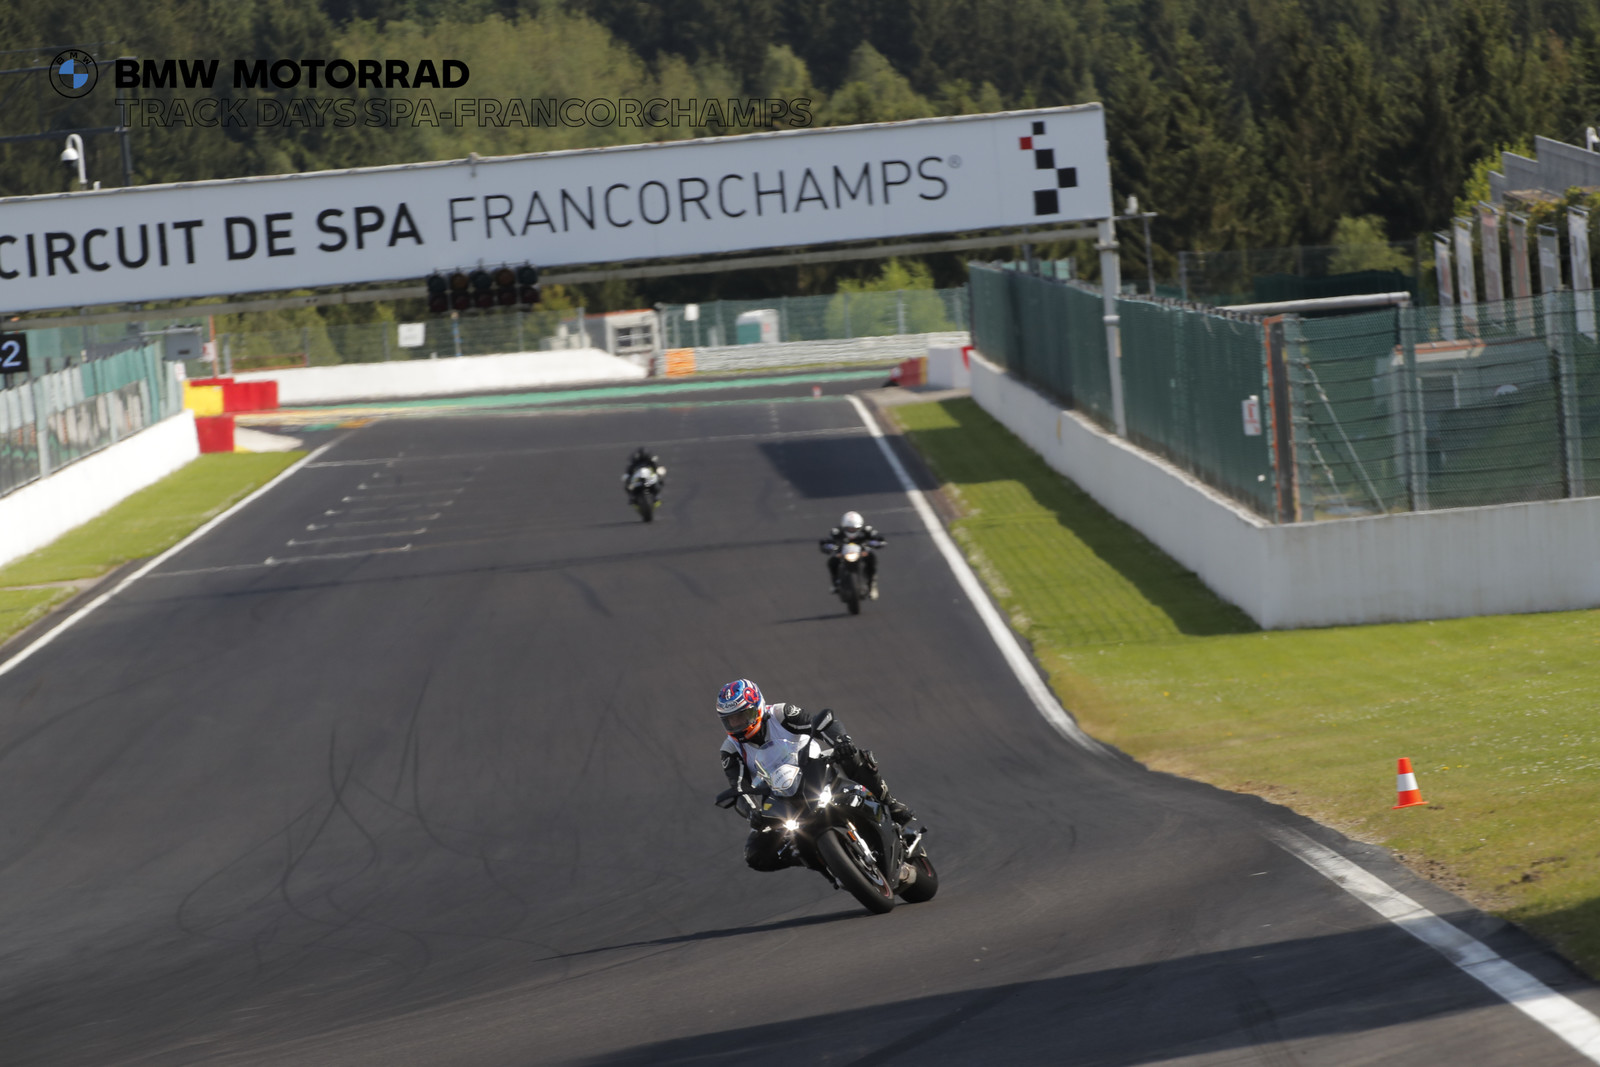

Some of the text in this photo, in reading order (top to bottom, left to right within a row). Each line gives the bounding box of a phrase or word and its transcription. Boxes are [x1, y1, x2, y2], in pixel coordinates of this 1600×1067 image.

[0, 155, 949, 280] CIRCUIT DE SPA FRANCORCHAMPS
